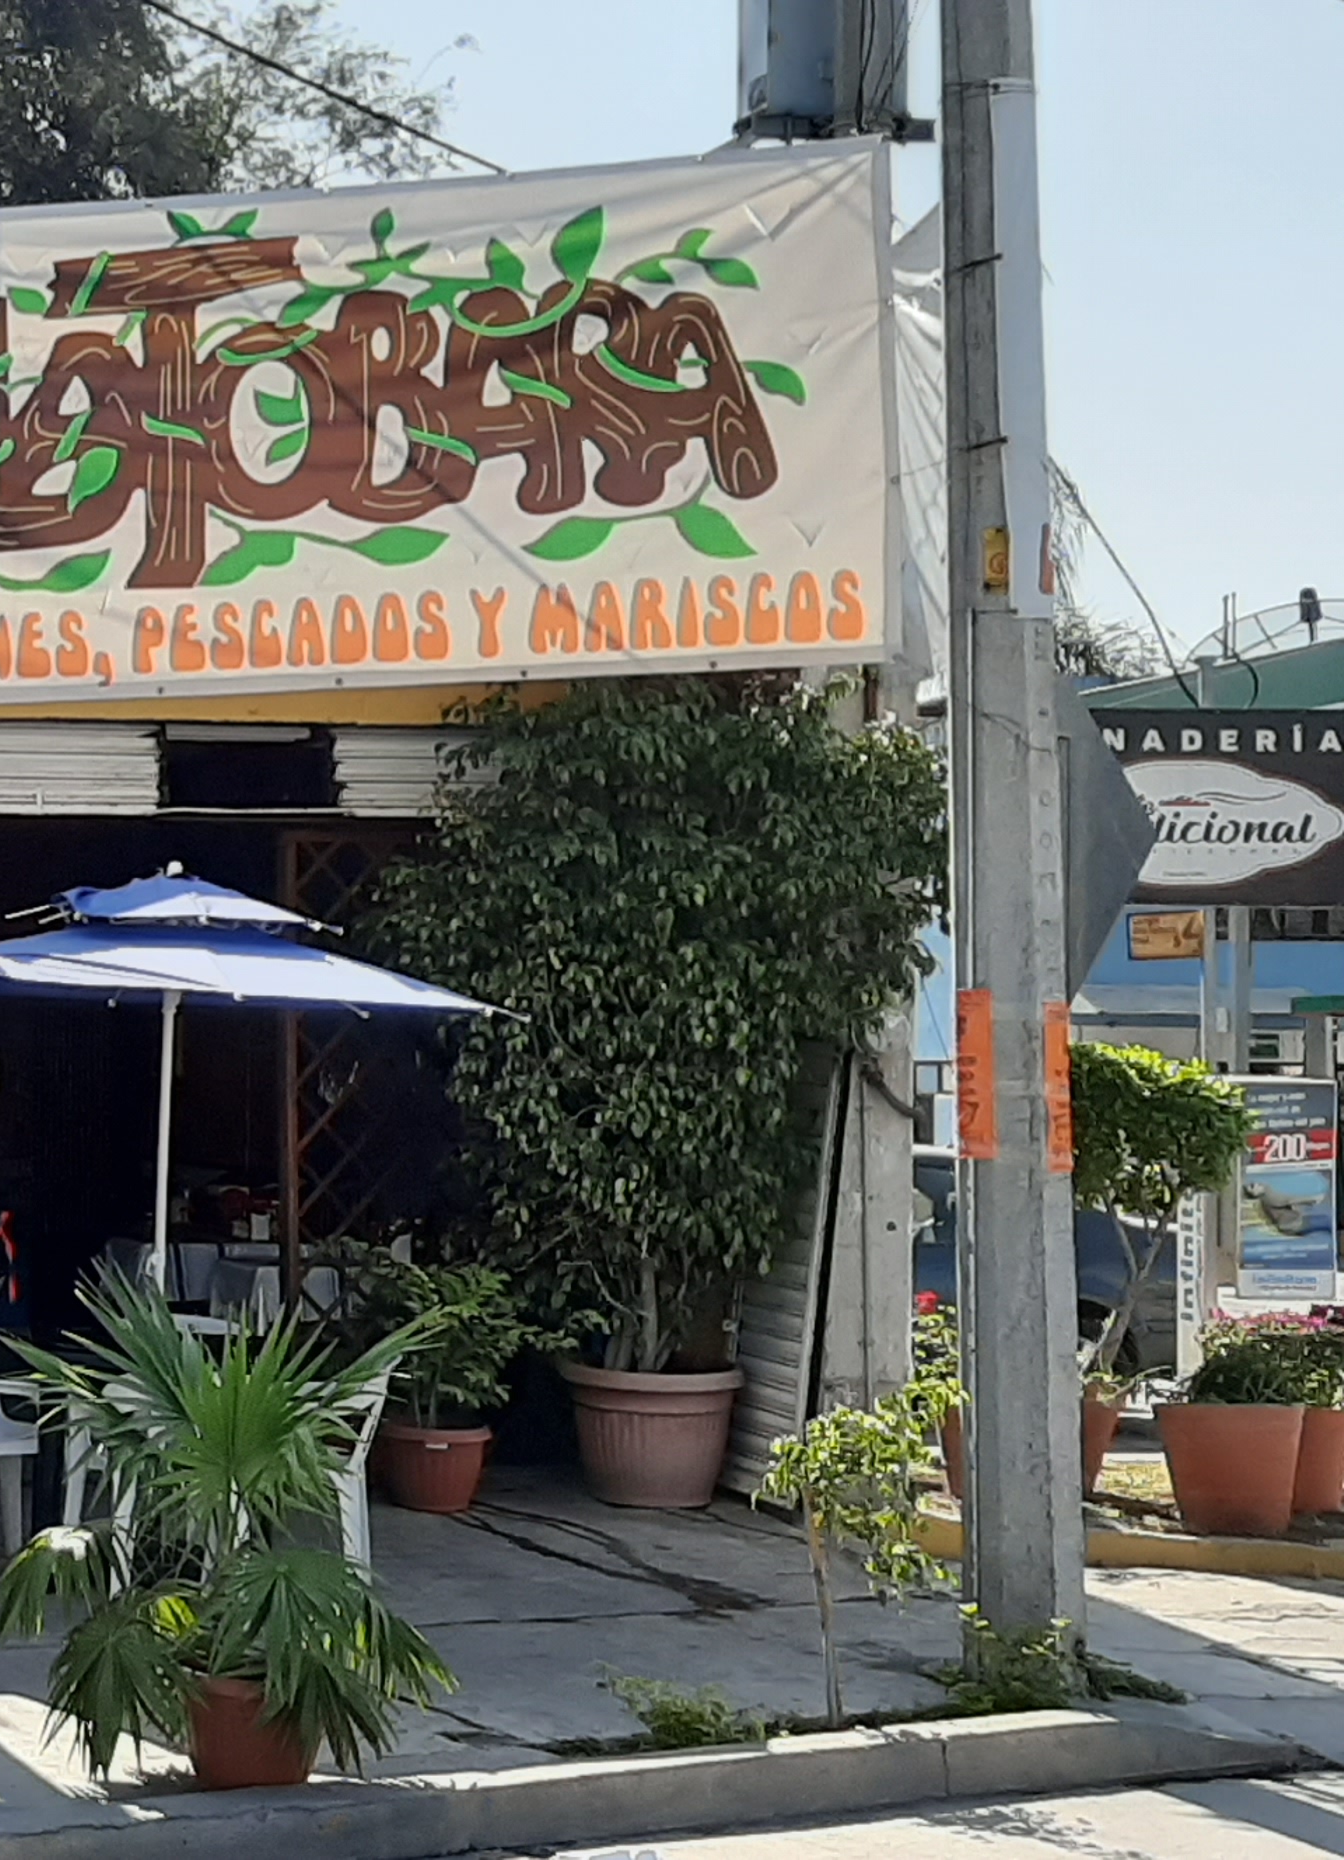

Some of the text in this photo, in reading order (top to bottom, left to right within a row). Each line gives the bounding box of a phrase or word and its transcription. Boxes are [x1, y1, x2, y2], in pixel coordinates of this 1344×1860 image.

[133, 590, 450, 674] PESCADOS
[470, 586, 507, 659] Y
[529, 569, 866, 655] MARISCOS
[1102, 723, 1342, 752] NADERÍA
[1263, 1134, 1307, 1162] 200
